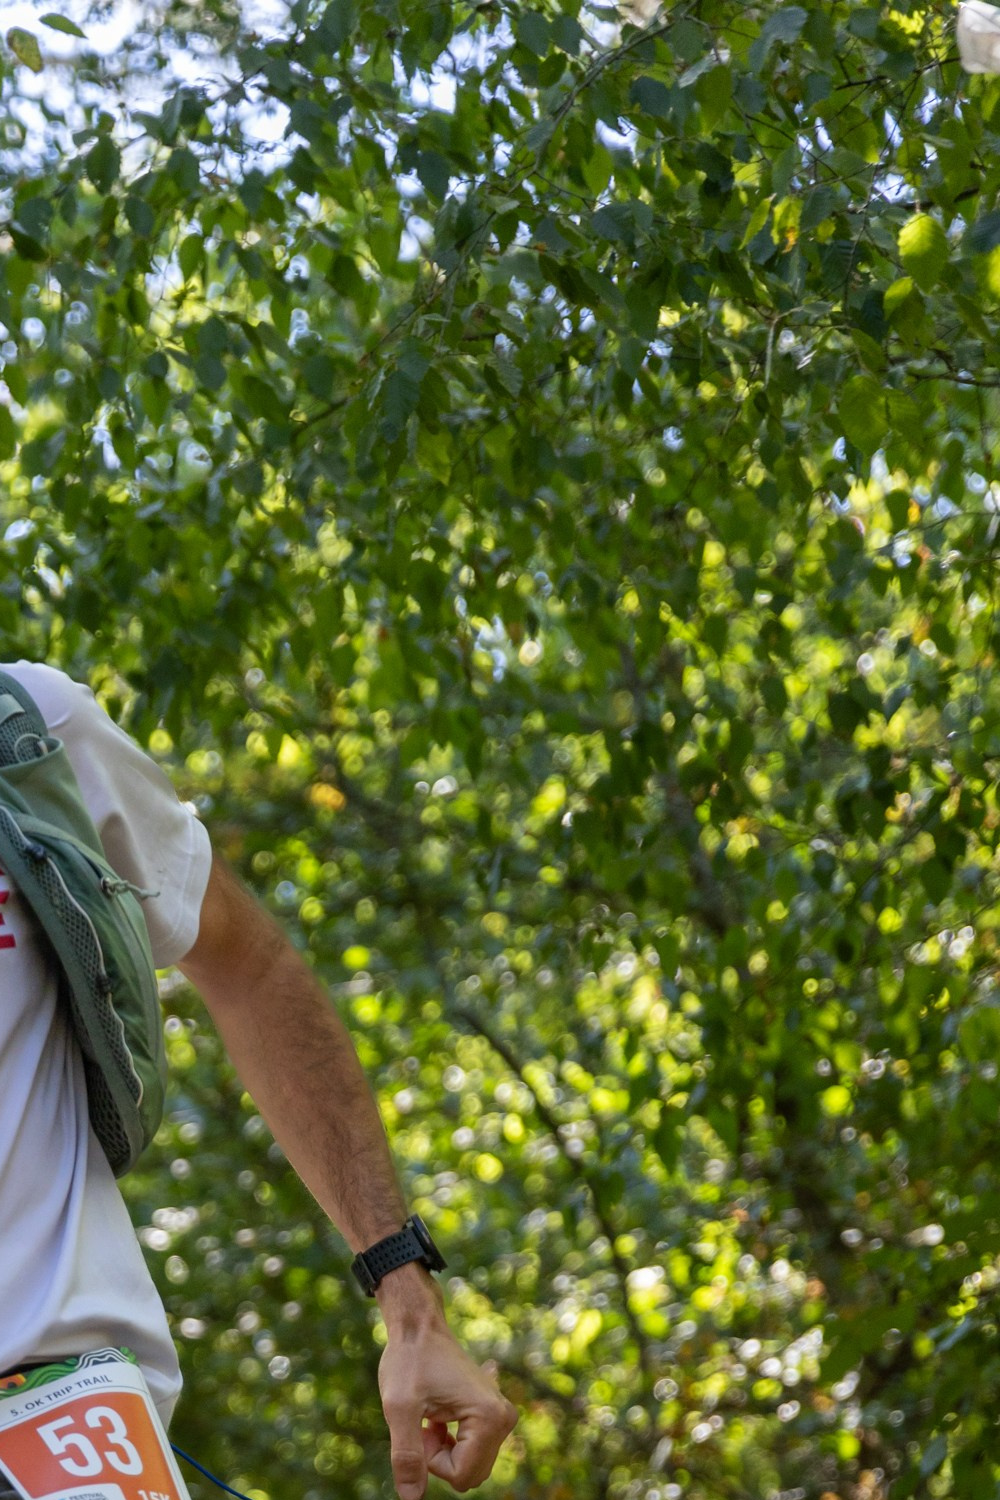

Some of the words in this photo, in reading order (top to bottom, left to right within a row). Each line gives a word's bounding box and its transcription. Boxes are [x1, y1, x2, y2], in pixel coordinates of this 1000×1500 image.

[25, 1399, 45, 1411] OK
[45, 1385, 73, 1402] TRIP
[74, 1374, 113, 1389] TRAIL
[36, 1405, 144, 1477] 53
